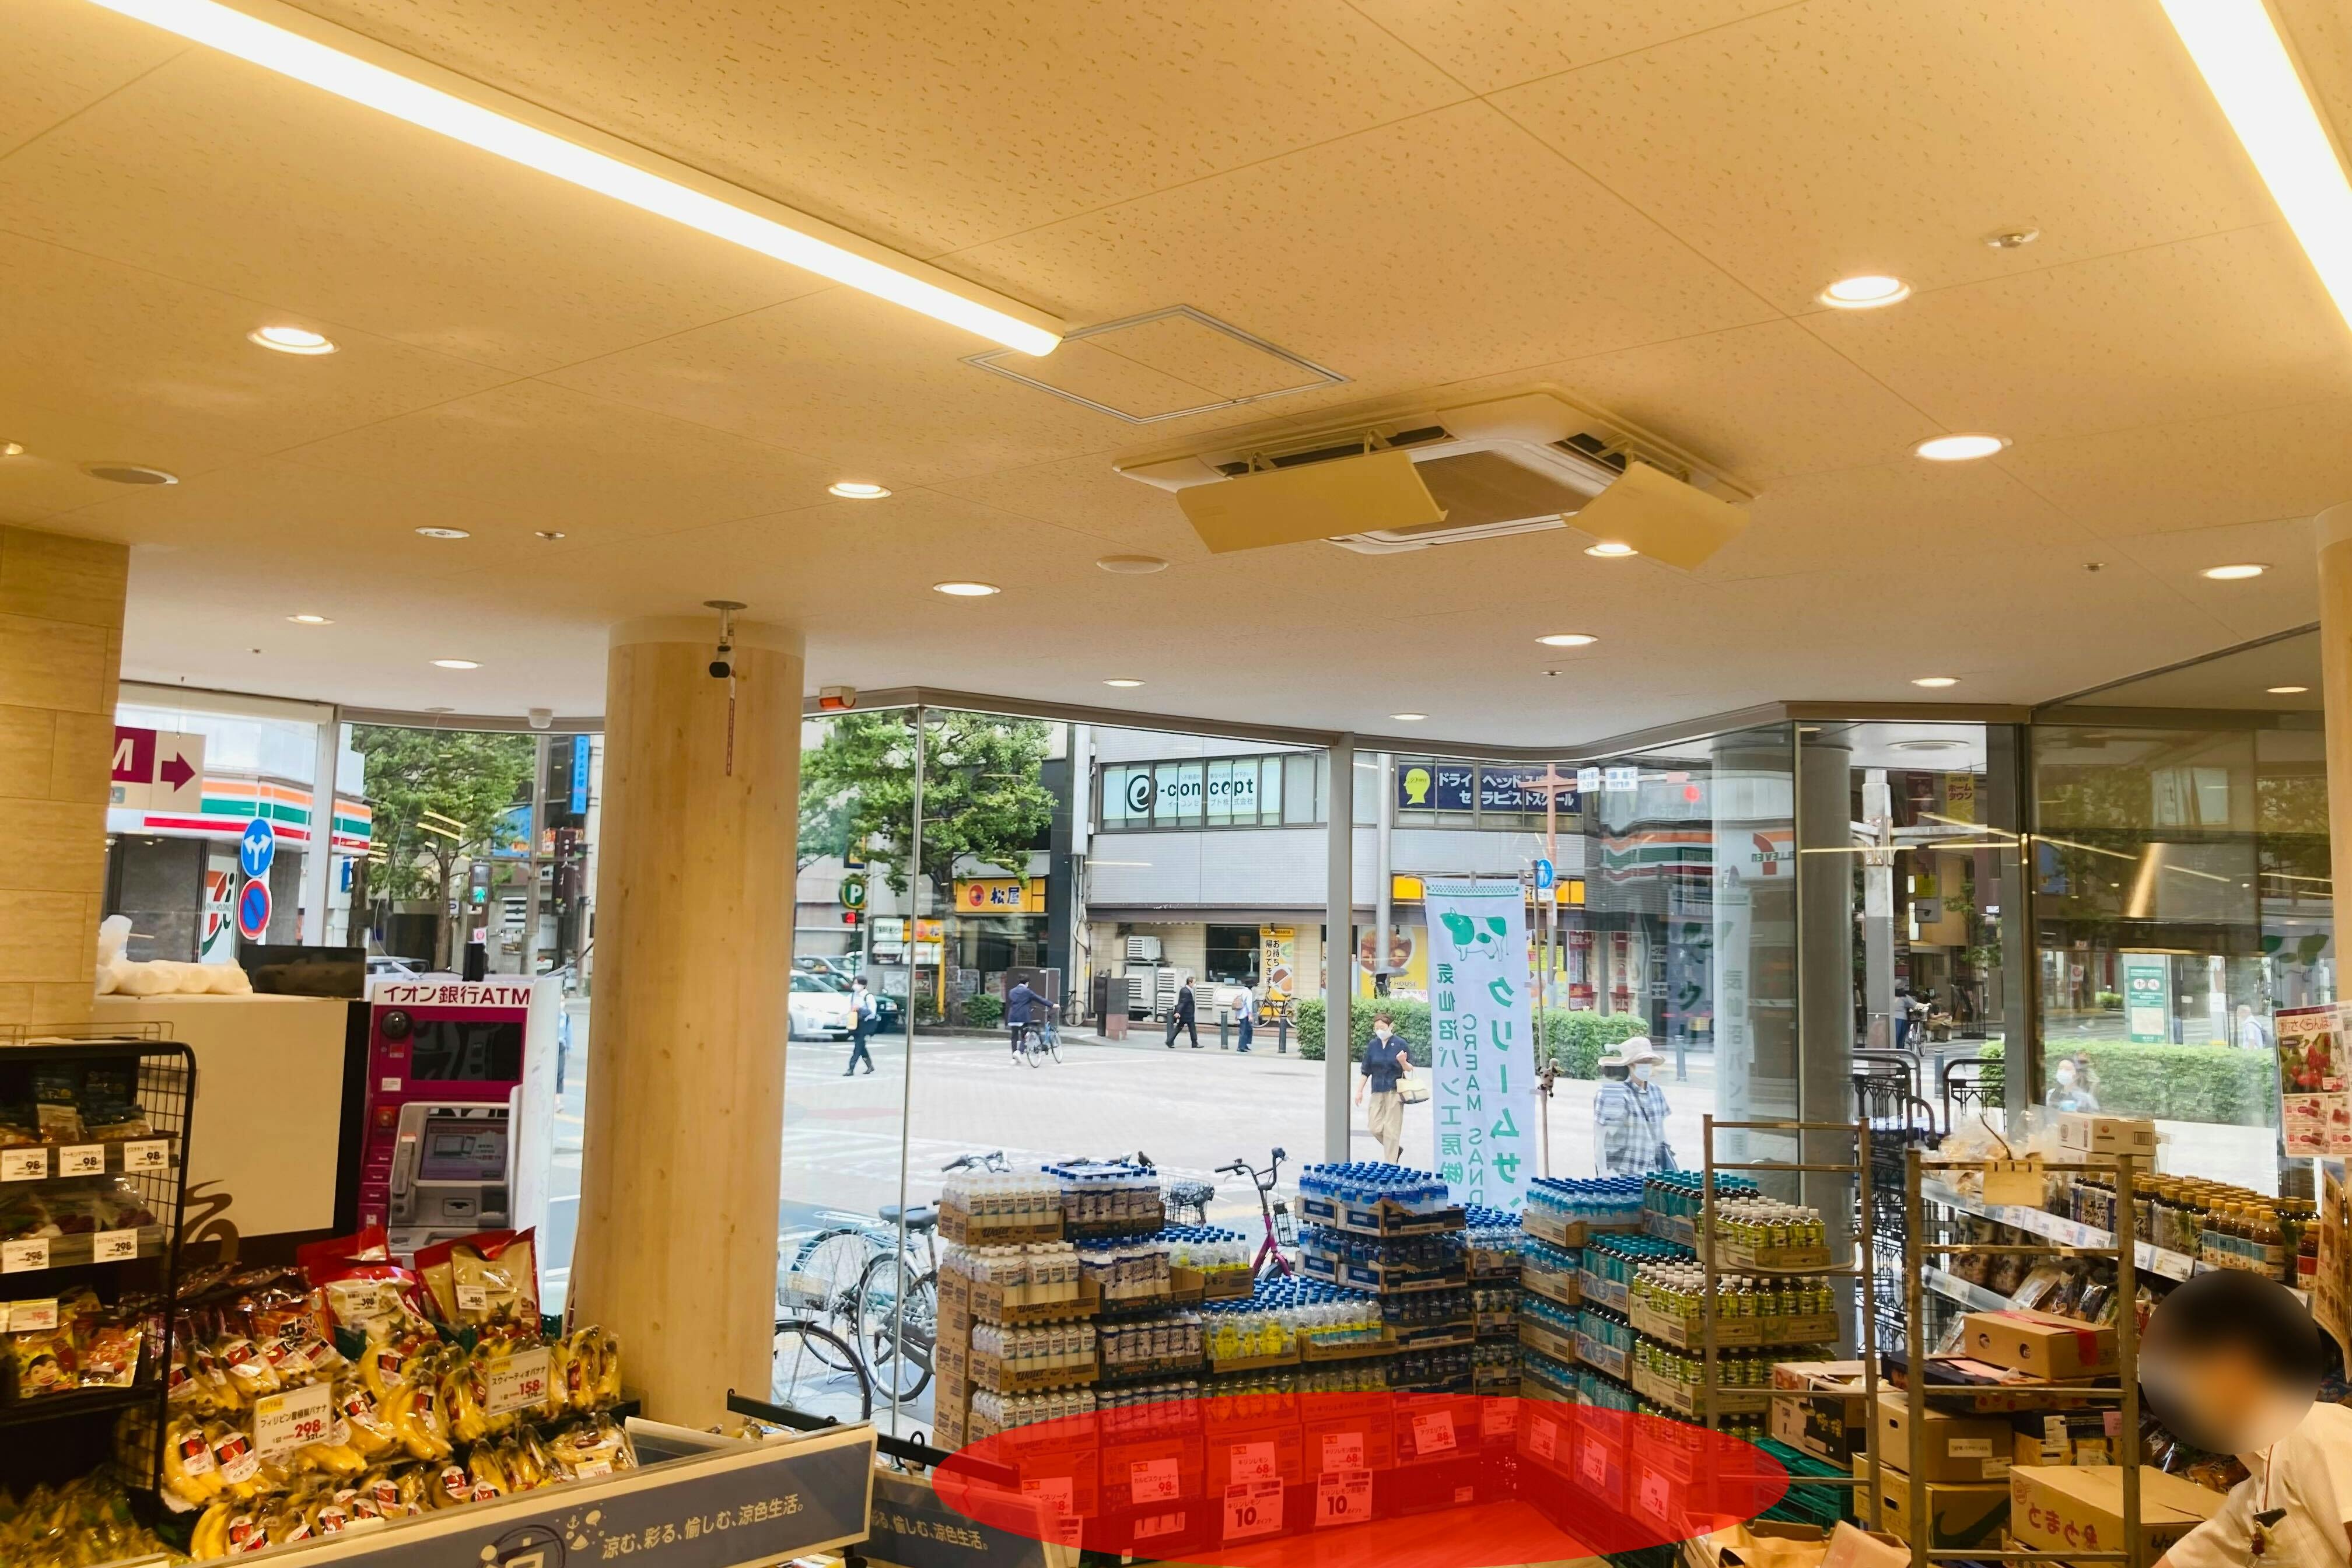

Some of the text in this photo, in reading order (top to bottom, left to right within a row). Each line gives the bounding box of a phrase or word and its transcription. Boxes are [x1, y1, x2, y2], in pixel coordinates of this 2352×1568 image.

[849, 883, 863, 904] P
[990, 886, 1020, 905] 松屋
[384, 985, 531, 1005] イオン銀行ATM
[519, 1379, 540, 1395] 158
[294, 1418, 321, 1438] 298
[1420, 1425, 1447, 1436] アクエリアス
[1238, 1457, 1268, 1465] キリンレモン
[1346, 1453, 1358, 1463] 68
[1256, 1464, 1269, 1474] 68
[1158, 1481, 1172, 1492] 98
[1227, 1498, 1261, 1509] キリンレモン
[1327, 1494, 1348, 1516] 10
[1236, 1506, 1257, 1528] 10
[2028, 1502, 2080, 1548] とまと
